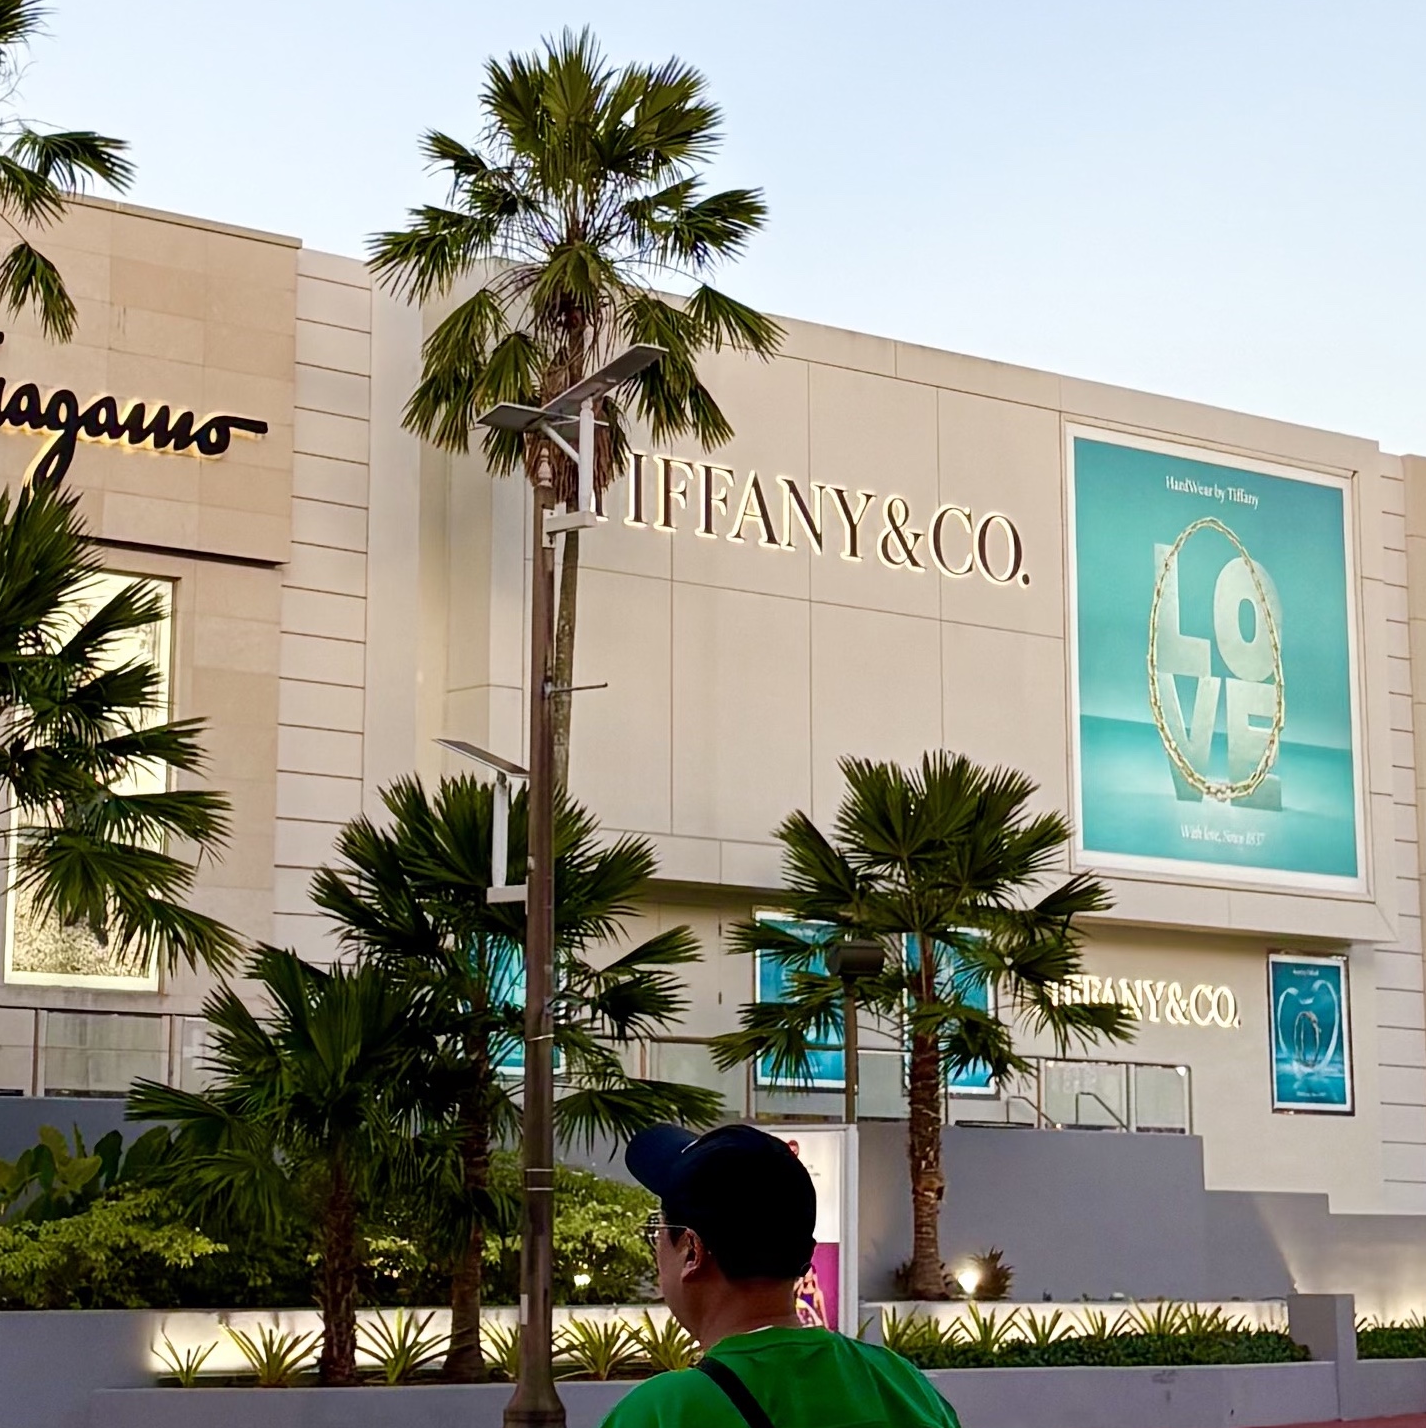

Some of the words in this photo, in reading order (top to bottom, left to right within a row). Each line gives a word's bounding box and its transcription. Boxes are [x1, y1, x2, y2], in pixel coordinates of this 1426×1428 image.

[583, 449, 1032, 588] IFFANY&CO.
[1214, 483, 1225, 504] by
[1227, 486, 1260, 510] Tiffany
